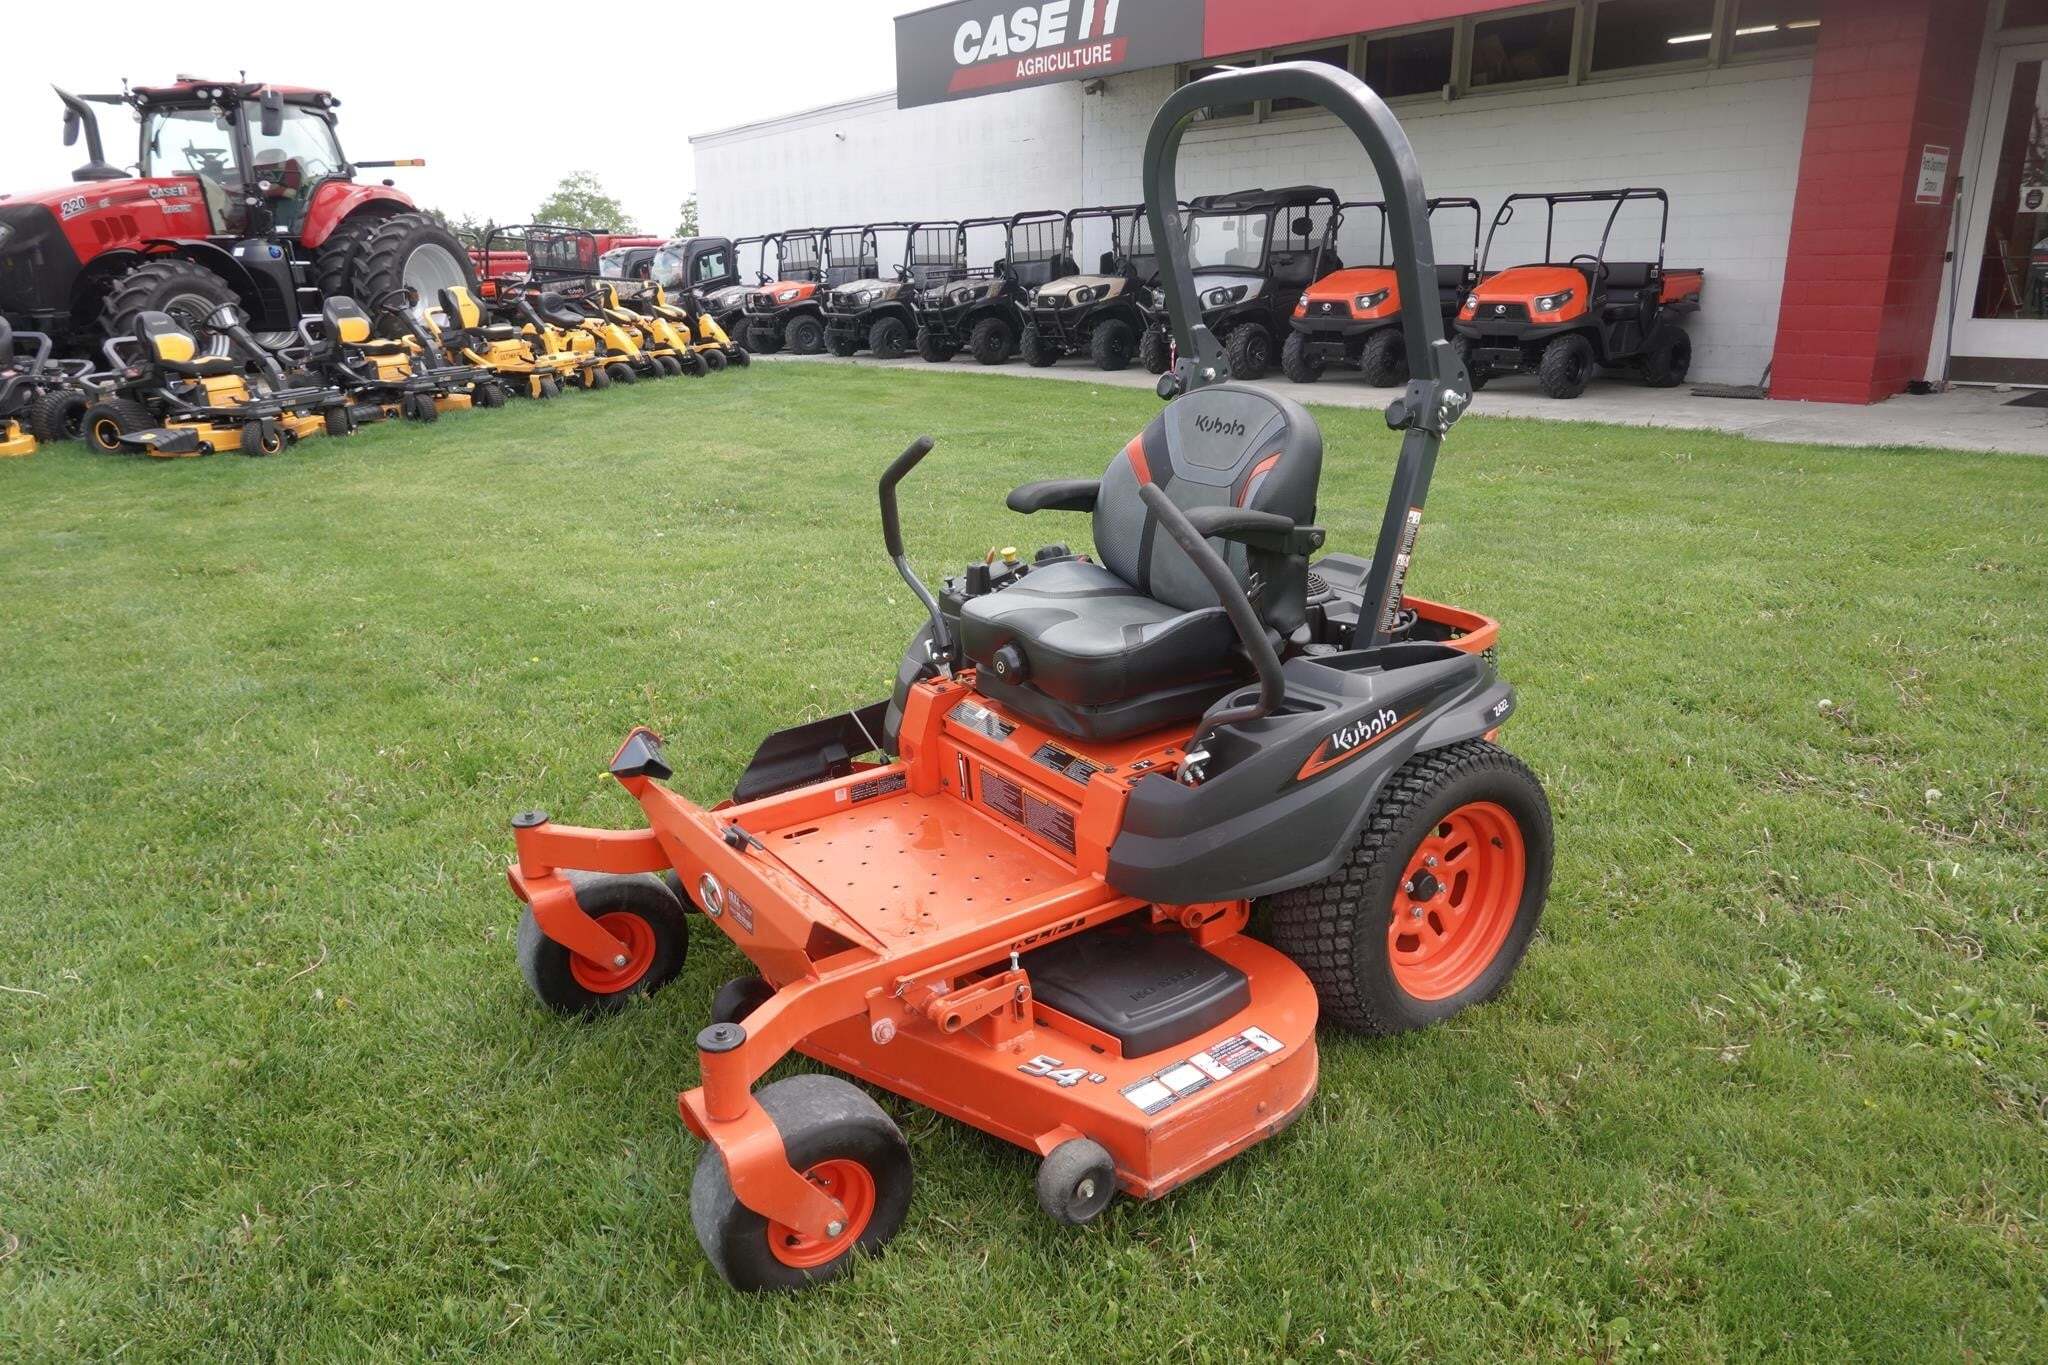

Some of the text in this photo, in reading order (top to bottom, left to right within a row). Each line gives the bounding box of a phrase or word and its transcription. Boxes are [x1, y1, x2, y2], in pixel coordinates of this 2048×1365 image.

[953, 0, 1070, 65] CASE
[1016, 44, 1112, 78] AGRICULTURE
[61, 196, 87, 215] 220
[1195, 414, 1246, 436] Kubota
[1332, 708, 1398, 750] Kubota
